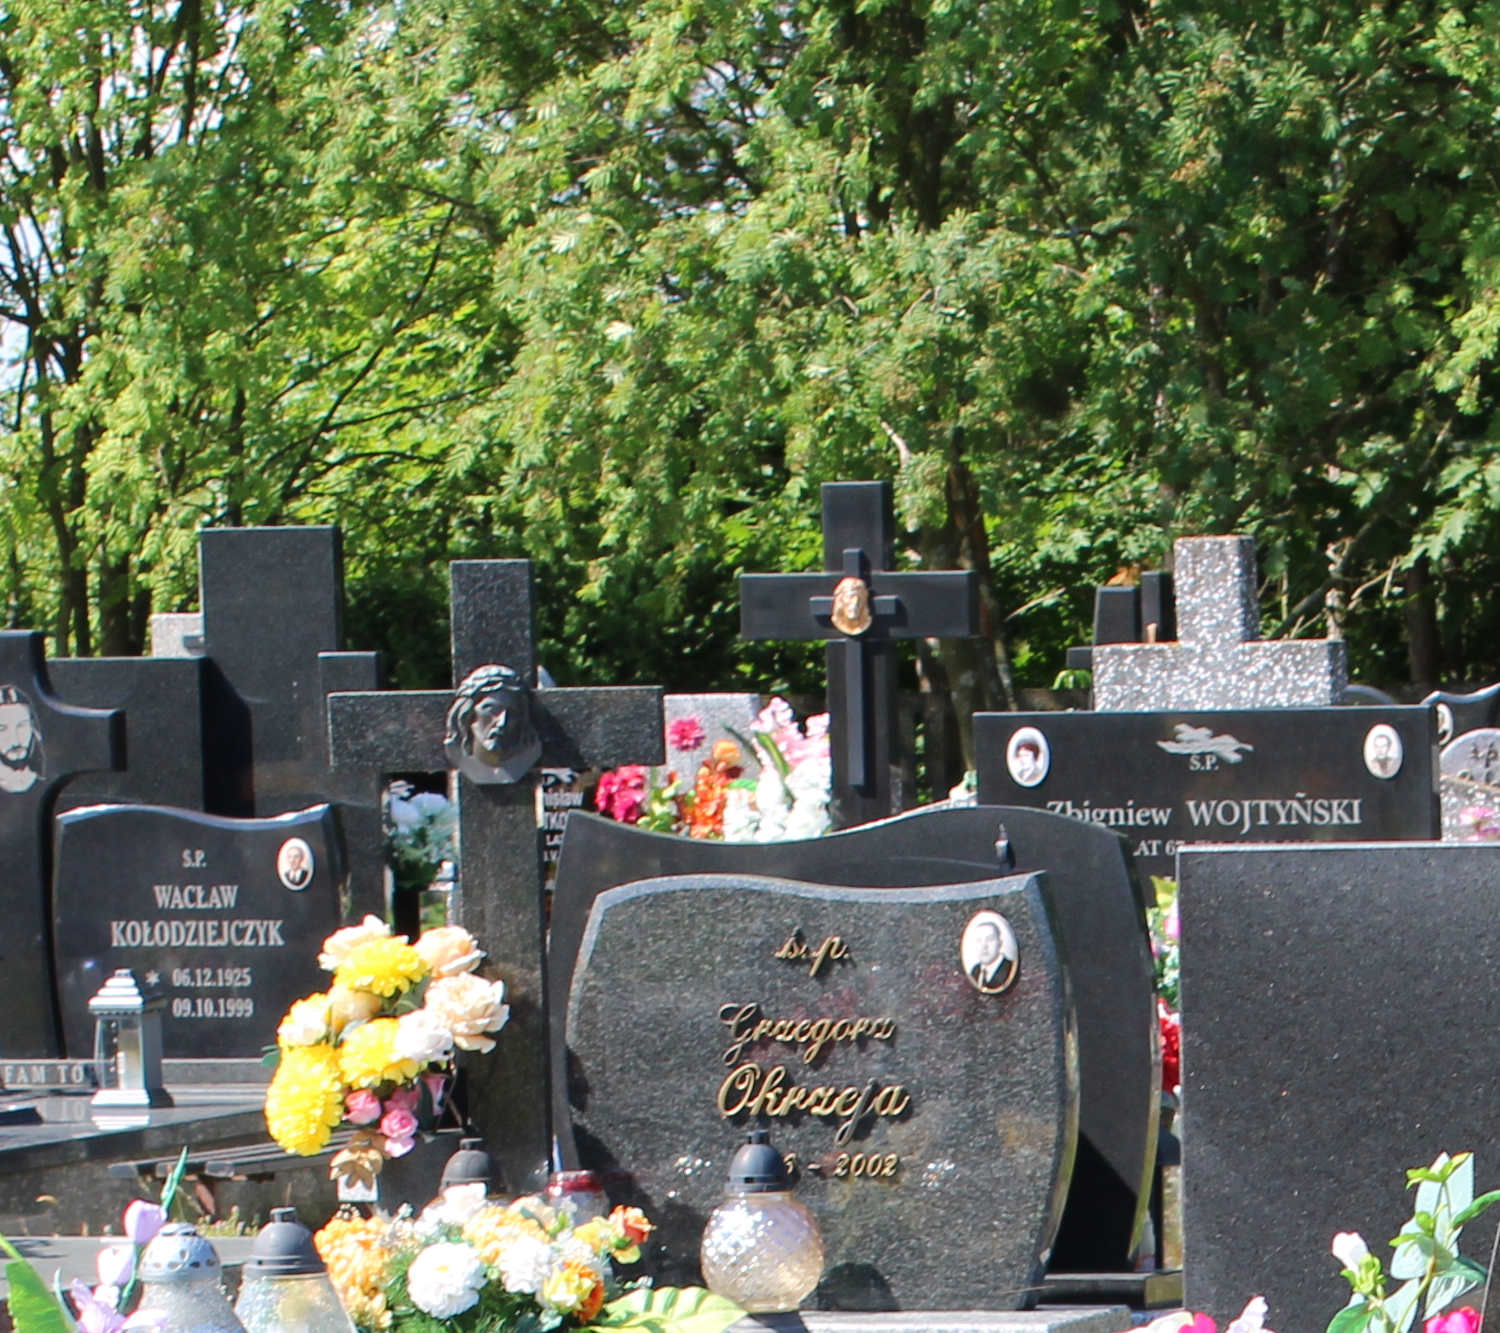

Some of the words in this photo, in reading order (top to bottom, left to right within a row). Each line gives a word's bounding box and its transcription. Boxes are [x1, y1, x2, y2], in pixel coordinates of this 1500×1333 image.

[1046, 800, 1172, 827] Zbigniew
[1185, 792, 1363, 834] WOJTYŃSKI
[1133, 839, 1162, 857] AT
[153, 885, 239, 910] WACŁAW
[110, 920, 285, 948] KOŁODZIEJCZYK
[171, 967, 252, 987] 06.12.1925
[171, 998, 254, 1018] 09.10.1999
[717, 1001, 897, 1067] Grzegorz
[4, 1064, 46, 1083] FAM
[716, 1062, 912, 1147] Okrzeja
[833, 1152, 900, 1178] 2002
